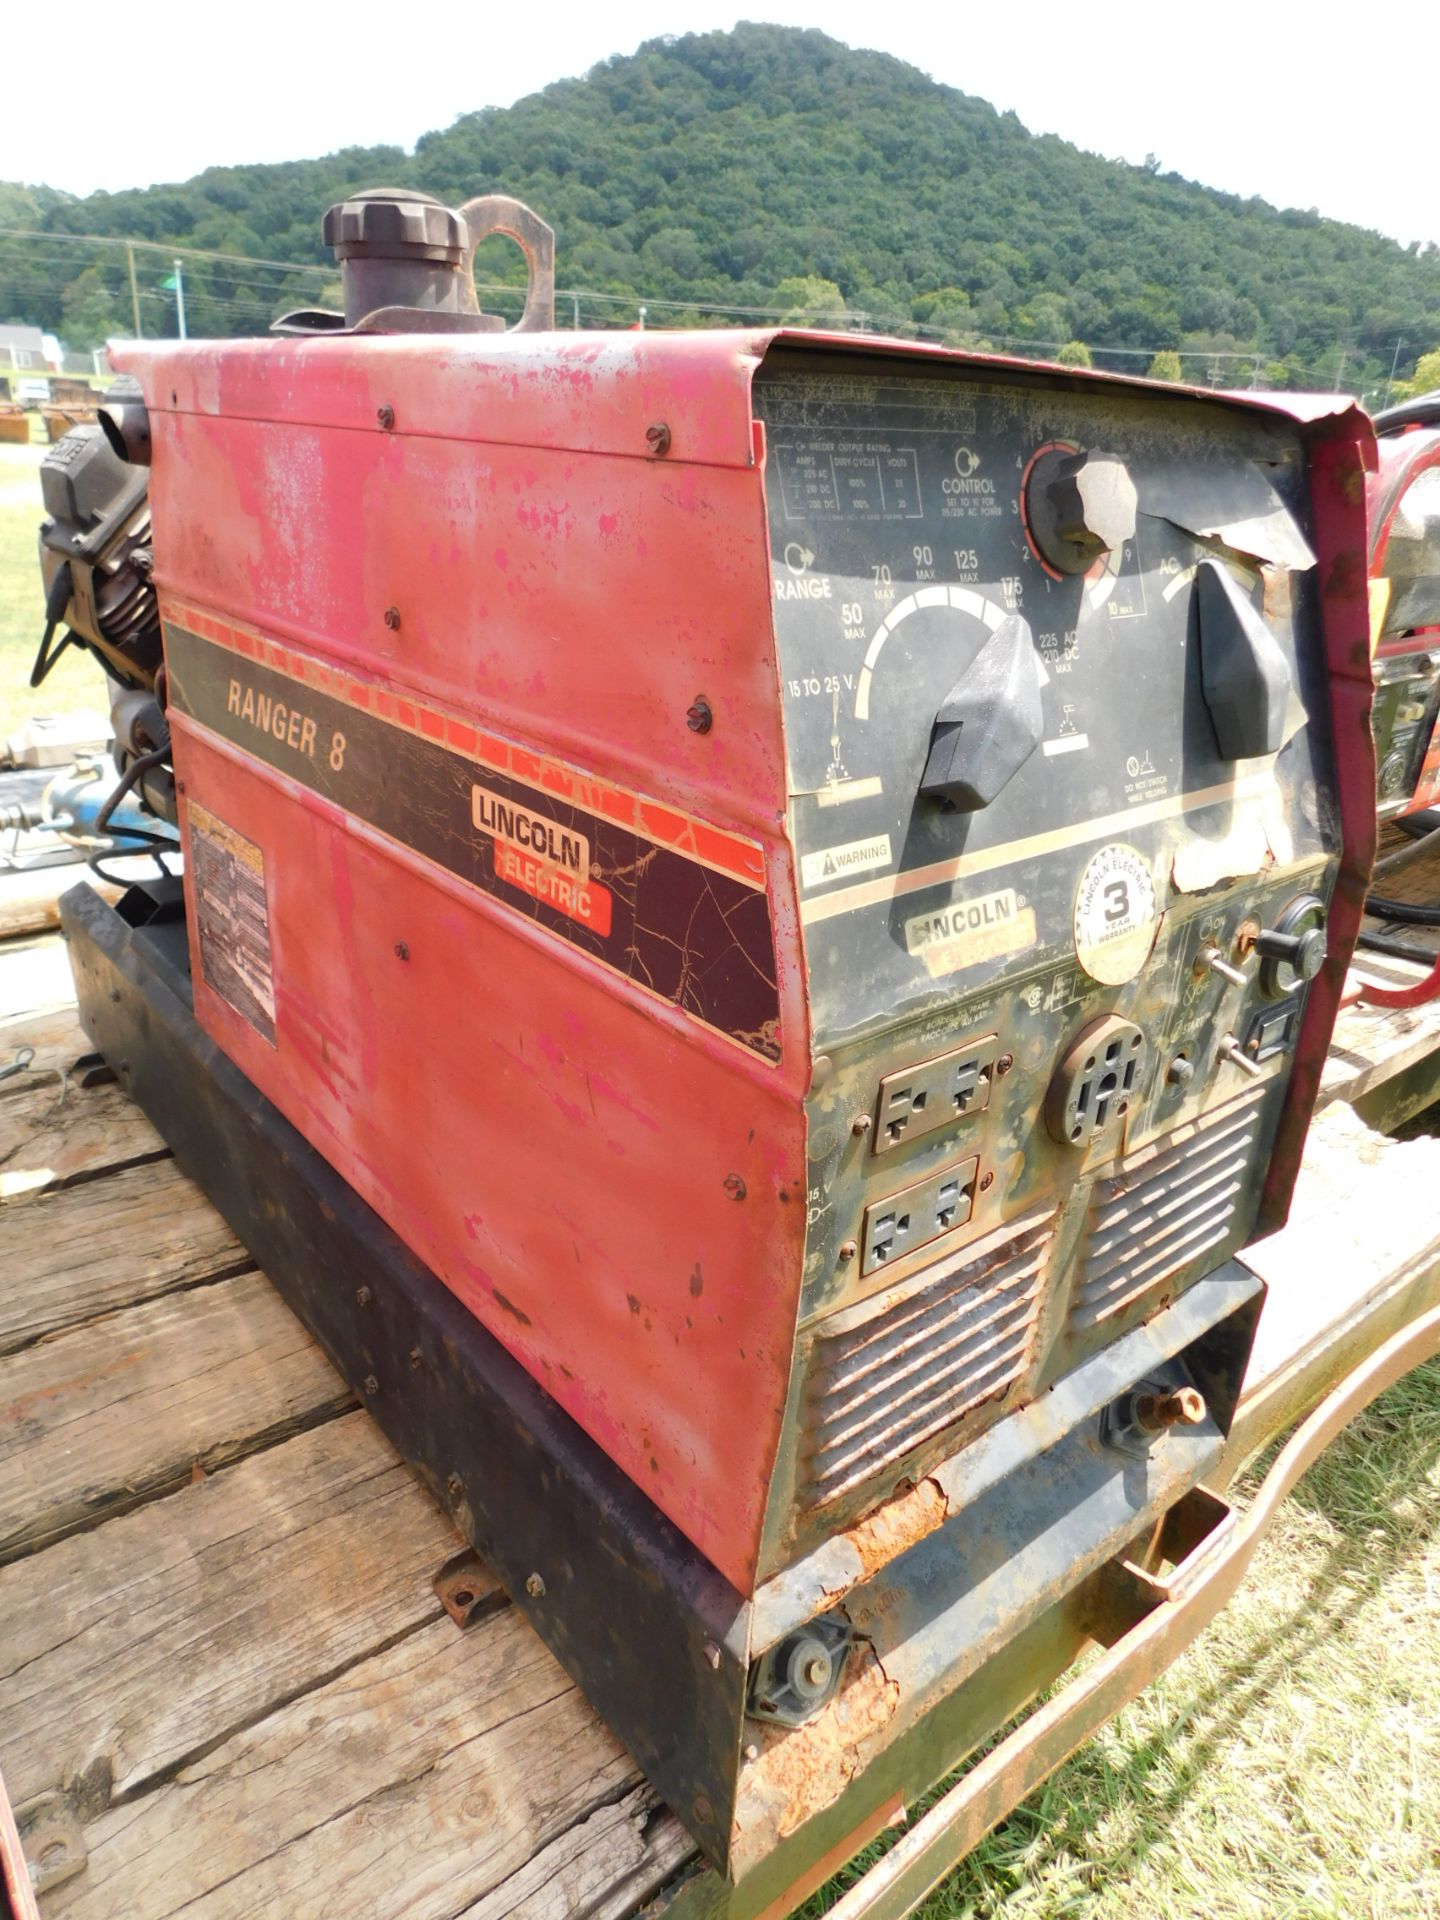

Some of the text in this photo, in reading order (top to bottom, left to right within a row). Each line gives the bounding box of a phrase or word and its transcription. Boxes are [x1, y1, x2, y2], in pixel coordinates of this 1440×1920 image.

[808, 442, 835, 452] WELDER
[838, 443, 864, 452] OUTPUT
[796, 456, 908, 468] AMPS DUTY CYCLE VOLTS
[1015, 455, 1022, 470] 4
[818, 469, 828, 479] AC
[820, 484, 831, 494] DC
[942, 478, 996, 494] CONTROL
[824, 500, 836, 509] DC
[946, 498, 957, 507] SET
[960, 497, 970, 506] TO
[982, 497, 995, 506] FOR
[1010, 499, 1018, 514] 3
[968, 507, 978, 516] AC
[980, 506, 1002, 516] POWER
[912, 546, 933, 567] 90
[954, 550, 978, 570] 125
[1023, 546, 1030, 560] 2
[1125, 548, 1132, 562] 9
[1160, 557, 1179, 575] AC
[872, 565, 892, 586] 70
[916, 570, 936, 580] MAX
[960, 572, 979, 583] MAX
[775, 578, 832, 600] RANGE
[1000, 576, 1023, 596] 175
[1046, 579, 1050, 593] 1
[874, 588, 896, 600] MAX
[1006, 597, 1024, 609] MAX
[1108, 602, 1118, 616] 10
[842, 602, 862, 625] 50
[844, 628, 866, 640] MAX
[1039, 631, 1078, 648] 225 AC
[1043, 646, 1080, 664] 210 DC
[1056, 664, 1072, 674] MAX
[788, 674, 857, 698] 15 TO 25 V.
[228, 679, 346, 772] RANGER 8
[480, 795, 581, 873] LINCOLN
[836, 843, 888, 868] WARNING
[504, 854, 592, 918] ELECTRIC
[1084, 857, 1146, 916] LINCOLN ELECTRIC
[1104, 880, 1130, 922] 3
[912, 896, 1012, 947] INCOLN
[1105, 918, 1130, 931] YEAR
[1098, 924, 1136, 944] WARRANTY
[824, 1180, 833, 1194] V
